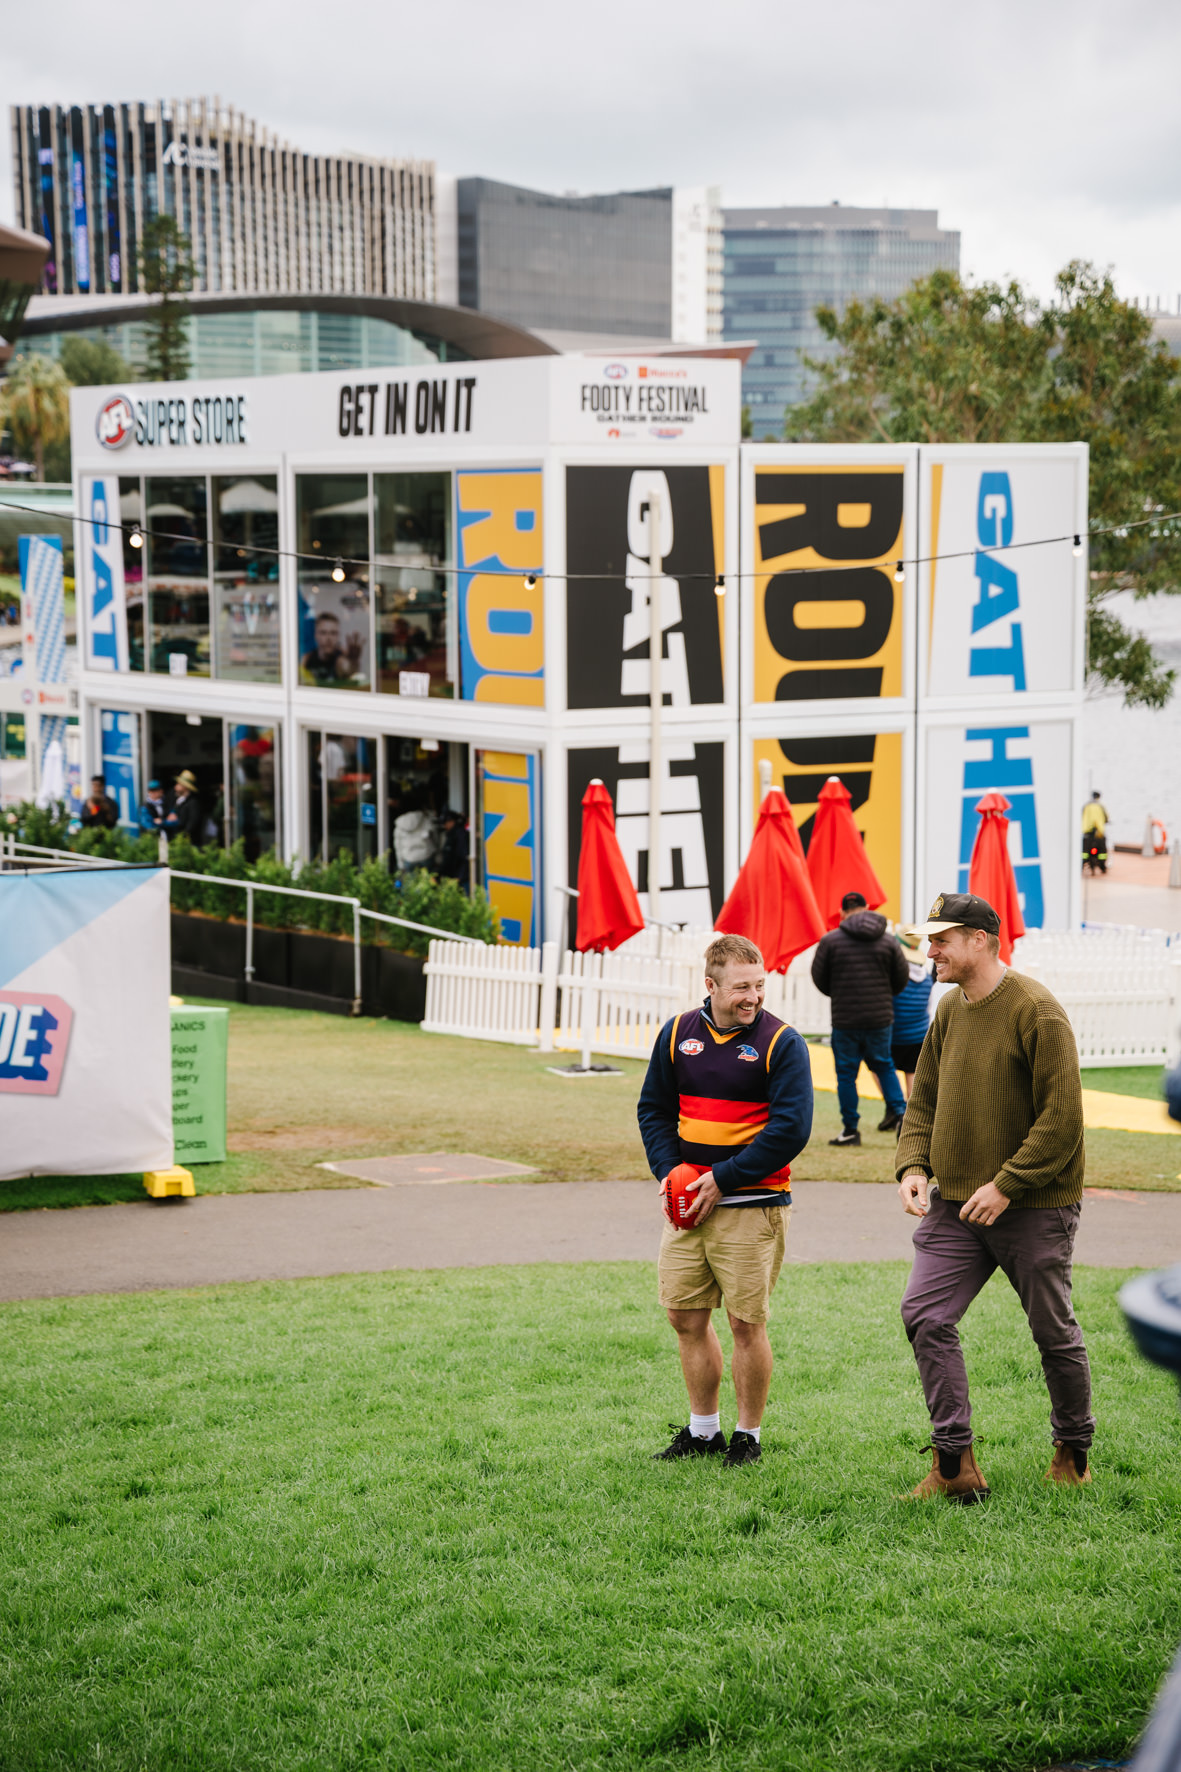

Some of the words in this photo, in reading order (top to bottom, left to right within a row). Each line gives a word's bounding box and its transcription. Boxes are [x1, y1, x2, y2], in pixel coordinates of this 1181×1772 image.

[339, 384, 378, 437] GET
[385, 382, 408, 435] IN
[415, 379, 447, 434] ON
[454, 377, 477, 432] IT
[581, 384, 632, 412] FOOTY
[638, 384, 708, 413] FESTIVAL
[100, 402, 134, 442] AFL
[136, 399, 187, 446] SUPER
[193, 395, 246, 444] STORE
[597, 414, 647, 423] GATHER
[650, 414, 693, 423] ROUND
[682, 1042, 704, 1052] AFL
